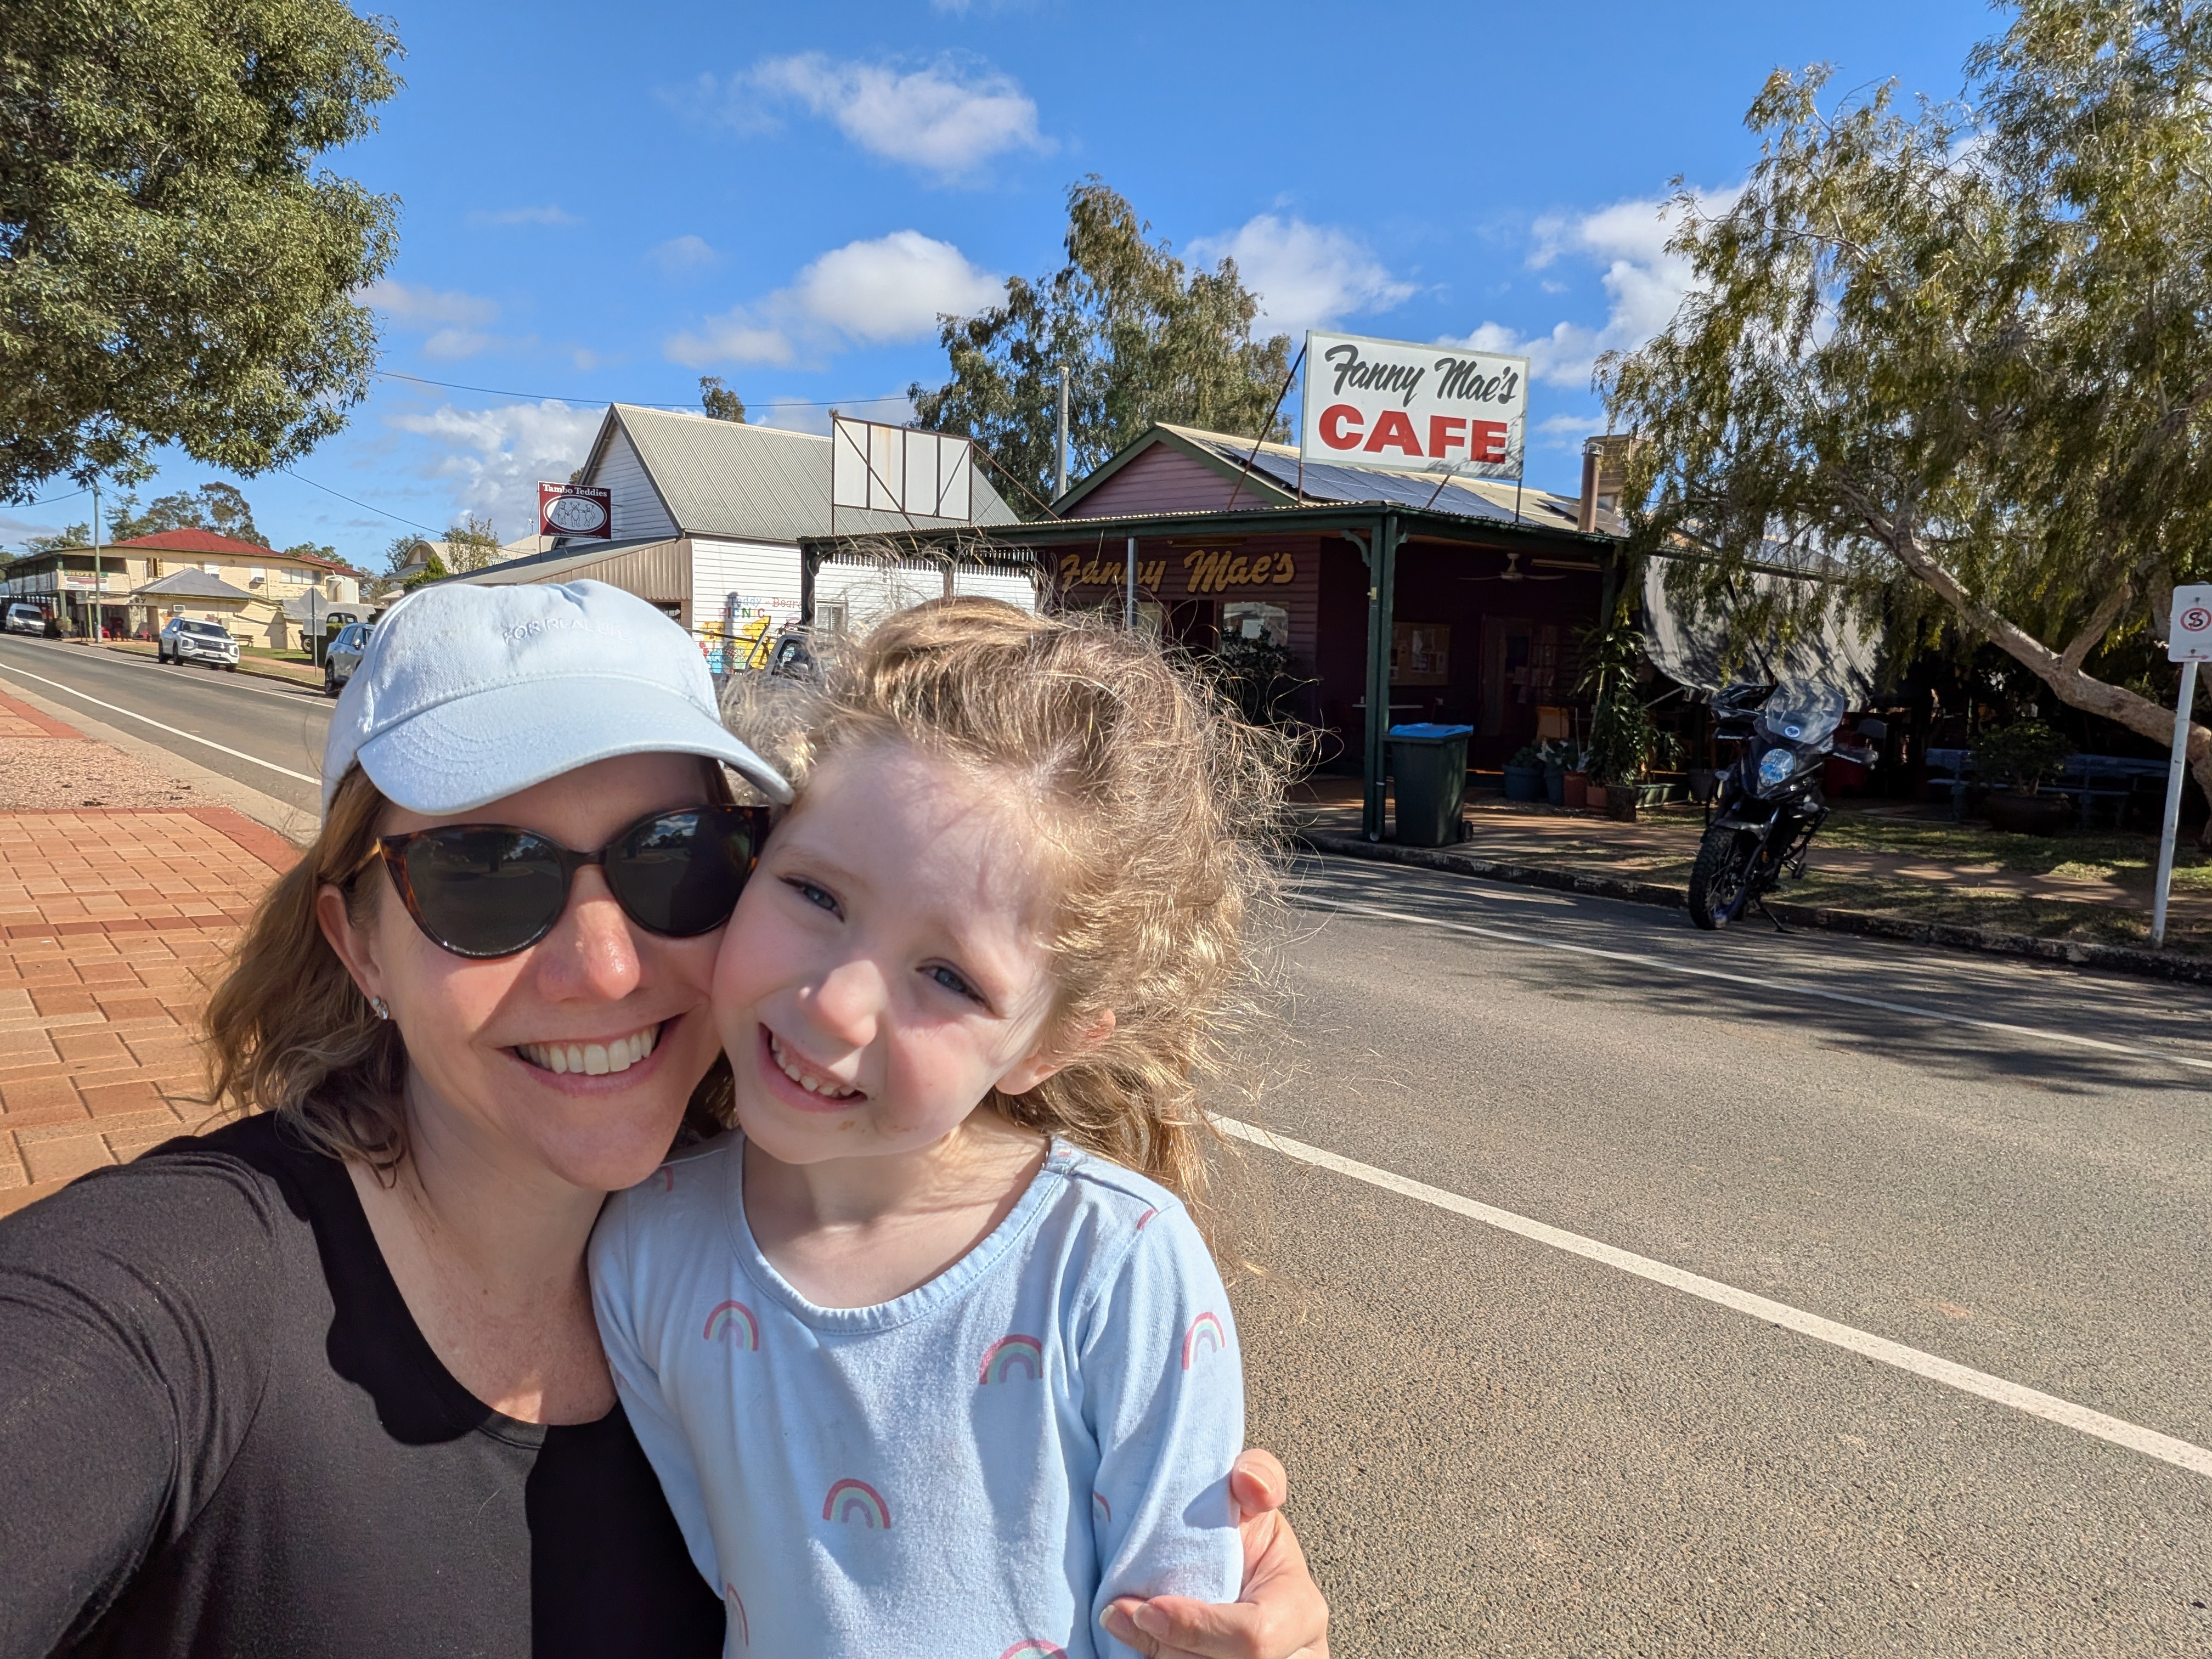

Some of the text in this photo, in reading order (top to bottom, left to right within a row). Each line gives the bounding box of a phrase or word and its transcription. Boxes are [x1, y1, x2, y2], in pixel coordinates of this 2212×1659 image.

[1325, 345, 1519, 407] Fanny Mae's
[1319, 404, 1507, 464] CAFE
[543, 484, 607, 497] Tambo Teddies
[1060, 550, 1295, 592] Fanny Mae's
[718, 606, 765, 619] PICNIC
[729, 594, 761, 607] Teddy
[502, 620, 541, 645] FOR
[545, 618, 594, 631] REAL
